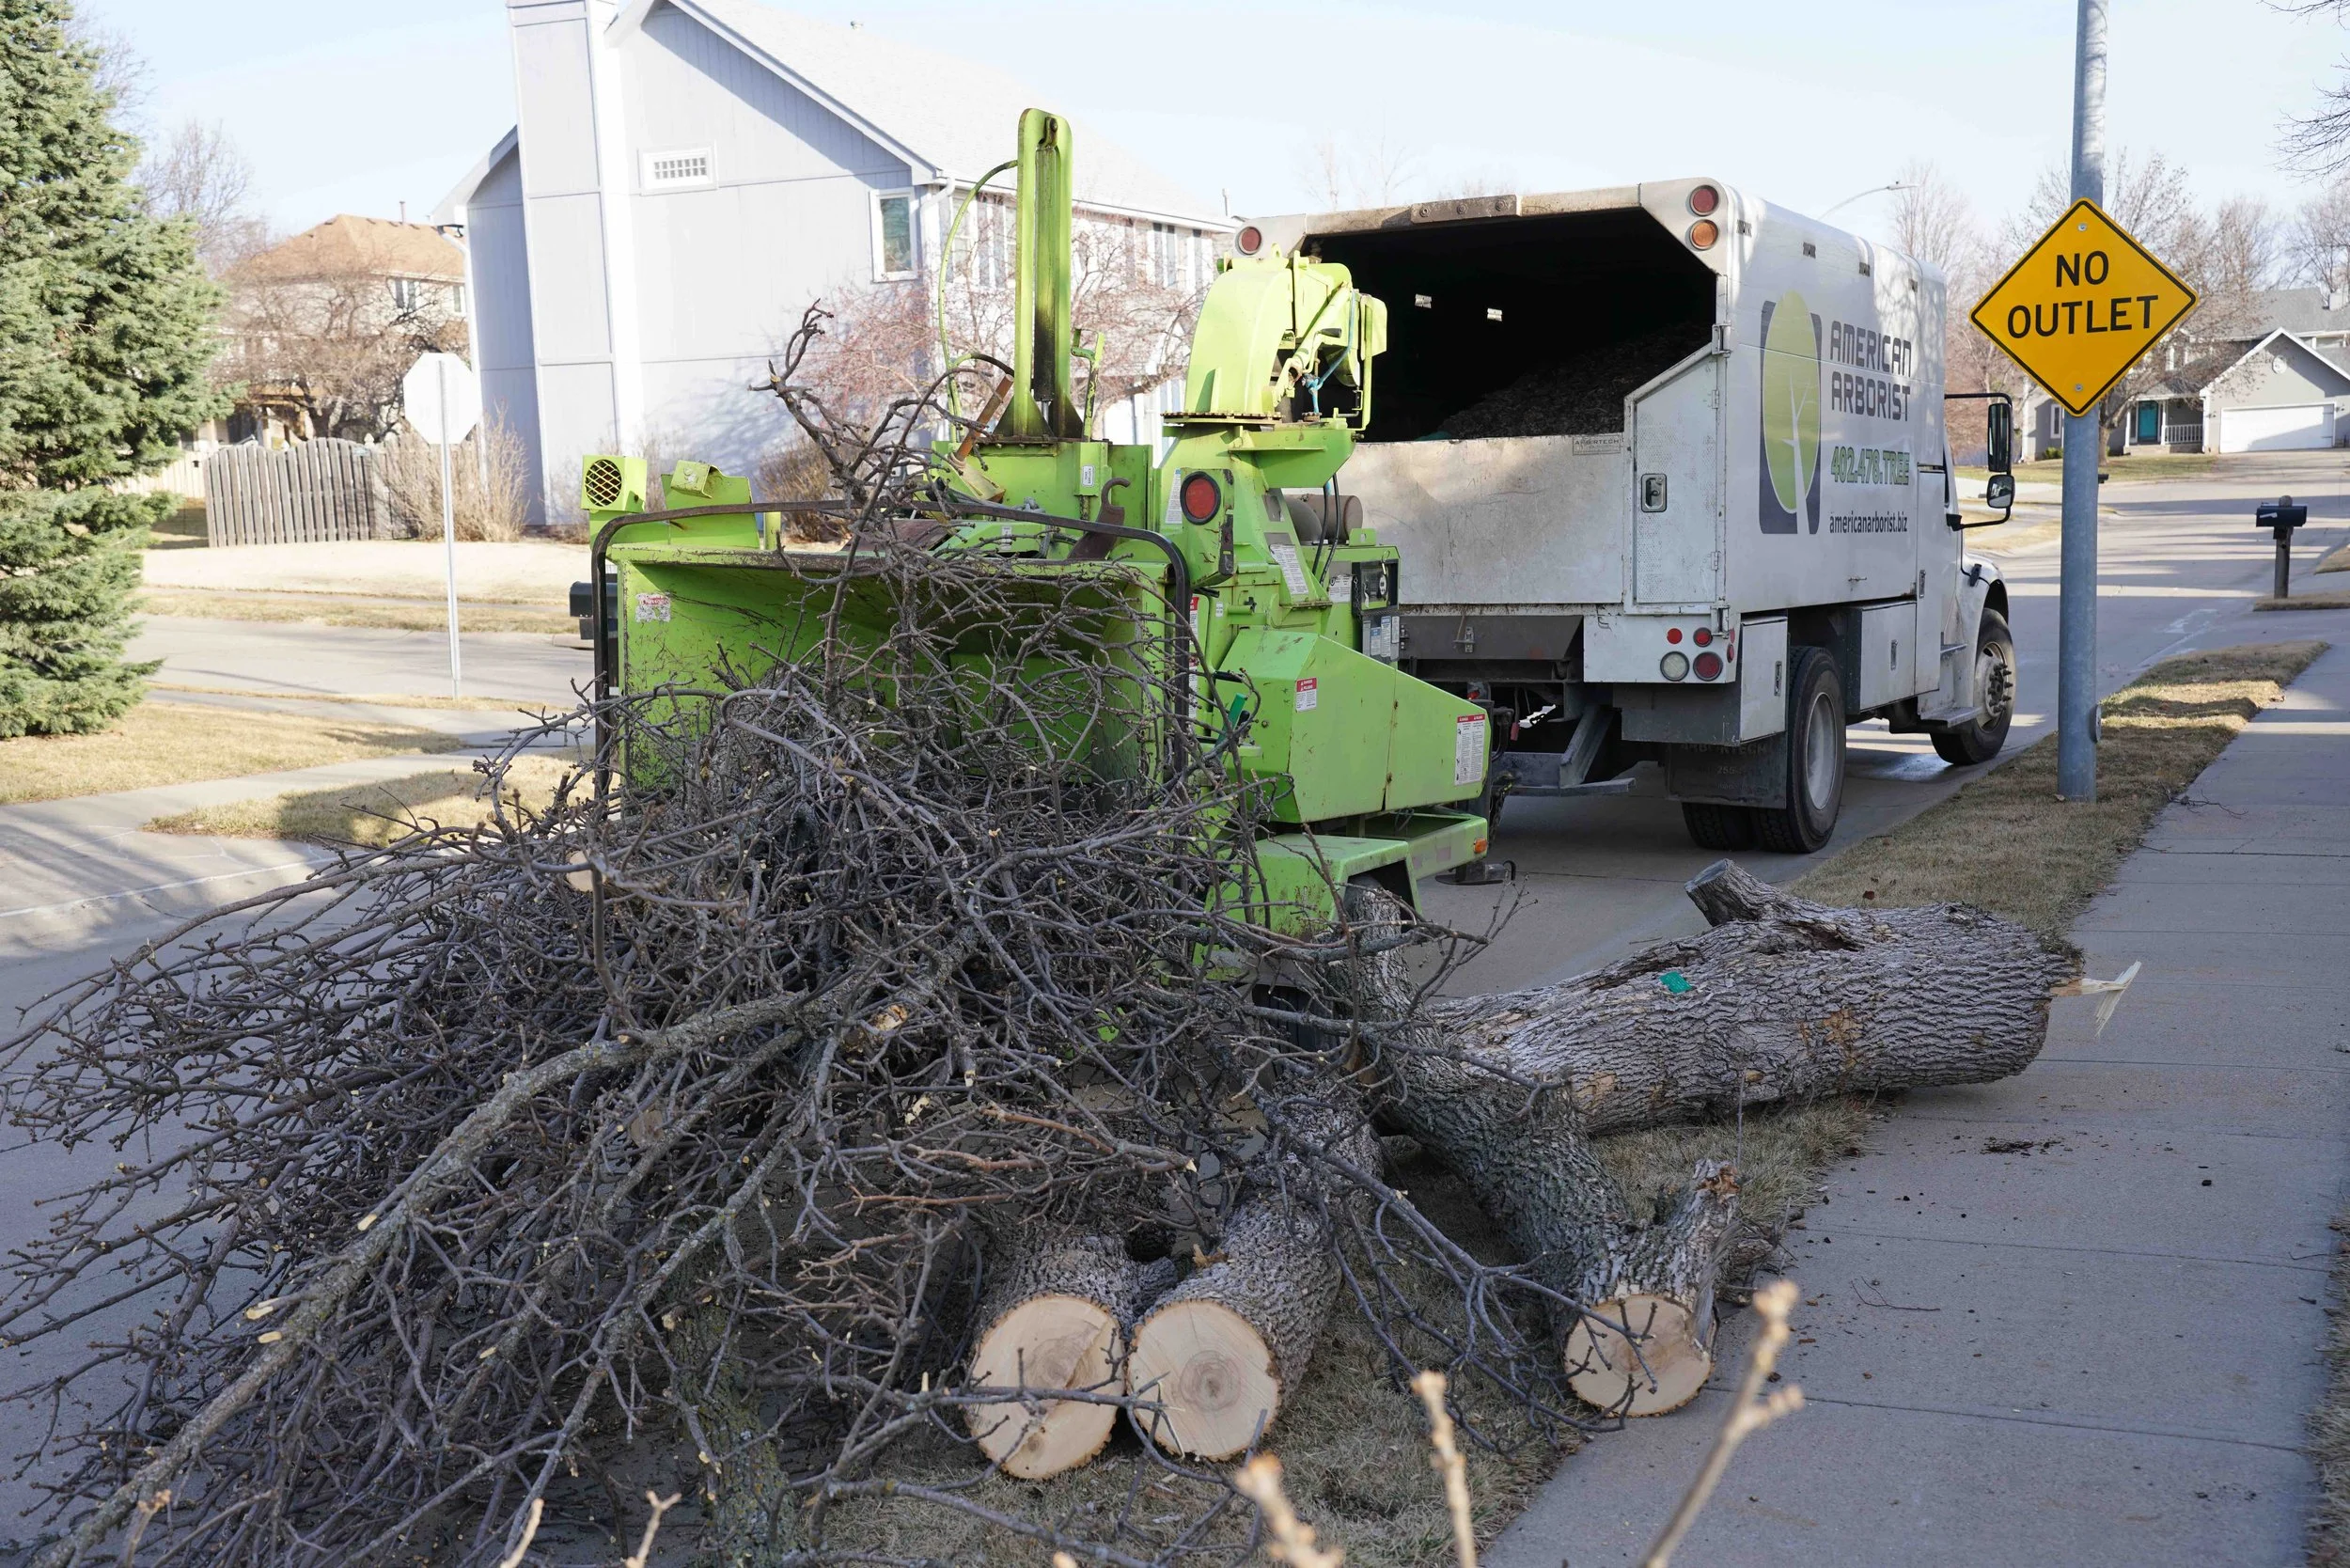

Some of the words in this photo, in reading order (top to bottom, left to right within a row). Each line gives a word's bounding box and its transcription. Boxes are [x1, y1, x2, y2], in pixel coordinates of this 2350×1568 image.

[2055, 250, 2109, 288] NO
[2007, 294, 2159, 339] OUTLET
[1829, 321, 1912, 378] AMERICAN
[1831, 370, 1911, 422] ARBORIST
[1830, 446, 1910, 486] 402.478.TREE
[1829, 510, 1907, 534] americanarborist.biz
